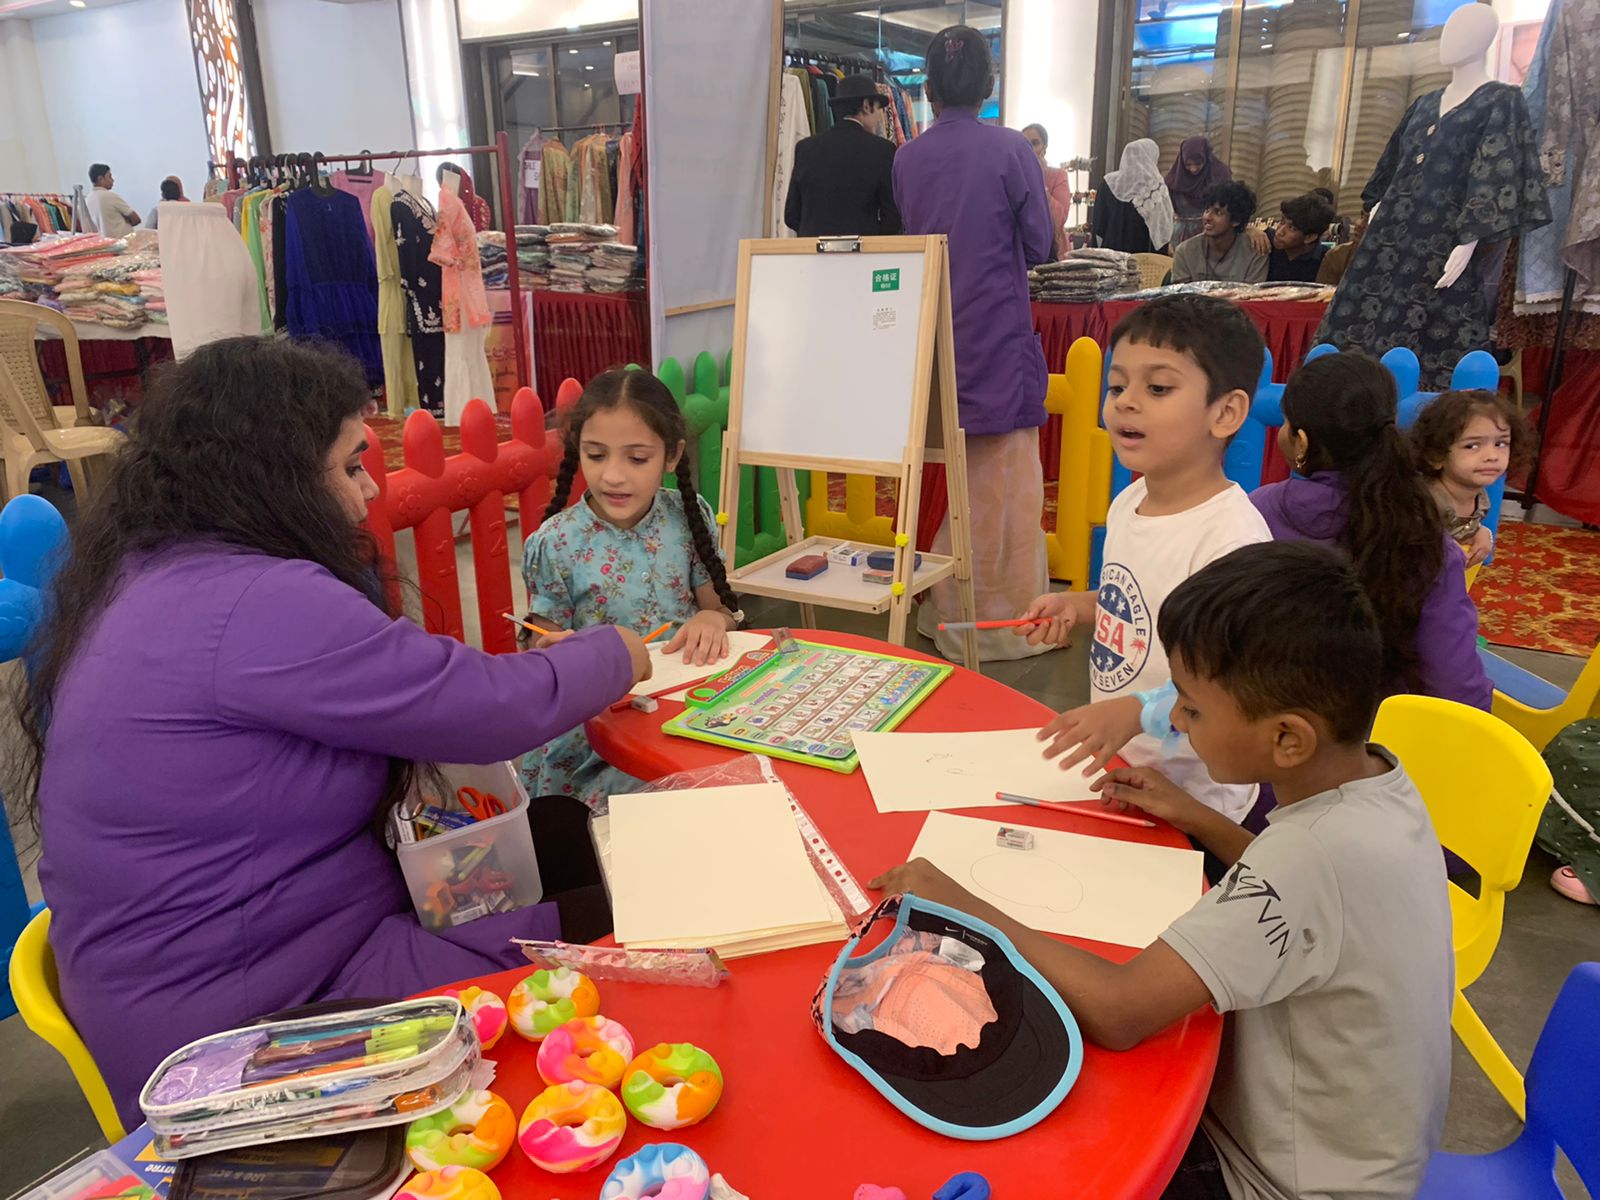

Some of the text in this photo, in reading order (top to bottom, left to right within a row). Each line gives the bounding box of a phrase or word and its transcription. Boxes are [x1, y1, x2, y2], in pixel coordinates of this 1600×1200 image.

[875, 272, 897, 283] 合格证
[1125, 583, 1146, 637] EAGLE
[1098, 662, 1135, 688] SEVEN
